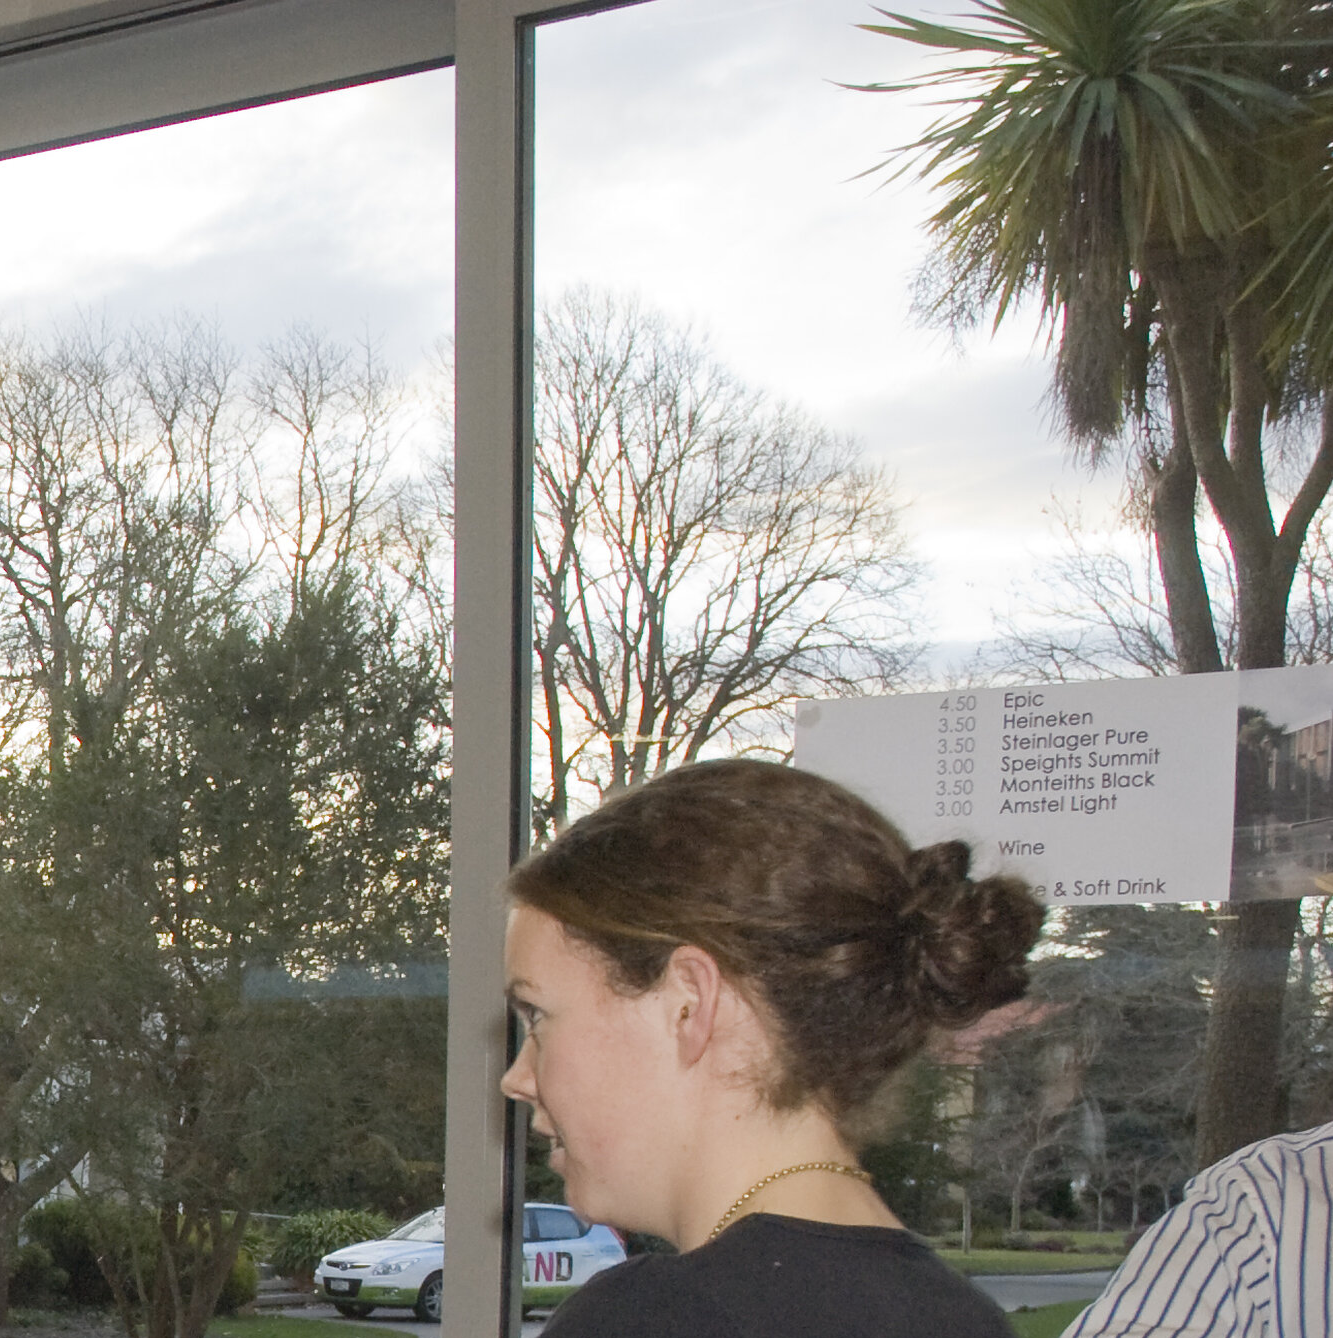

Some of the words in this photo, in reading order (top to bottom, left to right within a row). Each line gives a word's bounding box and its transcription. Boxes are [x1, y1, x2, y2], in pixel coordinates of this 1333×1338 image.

[940, 695, 977, 712] 4.50
[1003, 690, 1045, 711] Epic
[938, 716, 976, 733] 3.50
[1002, 709, 1094, 730] Heineken
[937, 737, 975, 754] 3.50
[1001, 730, 1101, 754] Steinlager
[1105, 727, 1150, 745] Pure
[936, 758, 975, 775] 3.00
[1000, 751, 1083, 776] Speights
[1087, 748, 1161, 768] Summit
[935, 779, 974, 796] 3.50
[999, 772, 1097, 794] Monteiths
[1101, 770, 1156, 789] Black
[934, 800, 973, 817] 3.00
[999, 795, 1066, 815] Amstel
[1071, 793, 1118, 816] Light
[999, 839, 1045, 857] Wine
[1053, 879, 1068, 897] &
[1073, 878, 1111, 897] Soft
[1117, 876, 1166, 897] Drink
